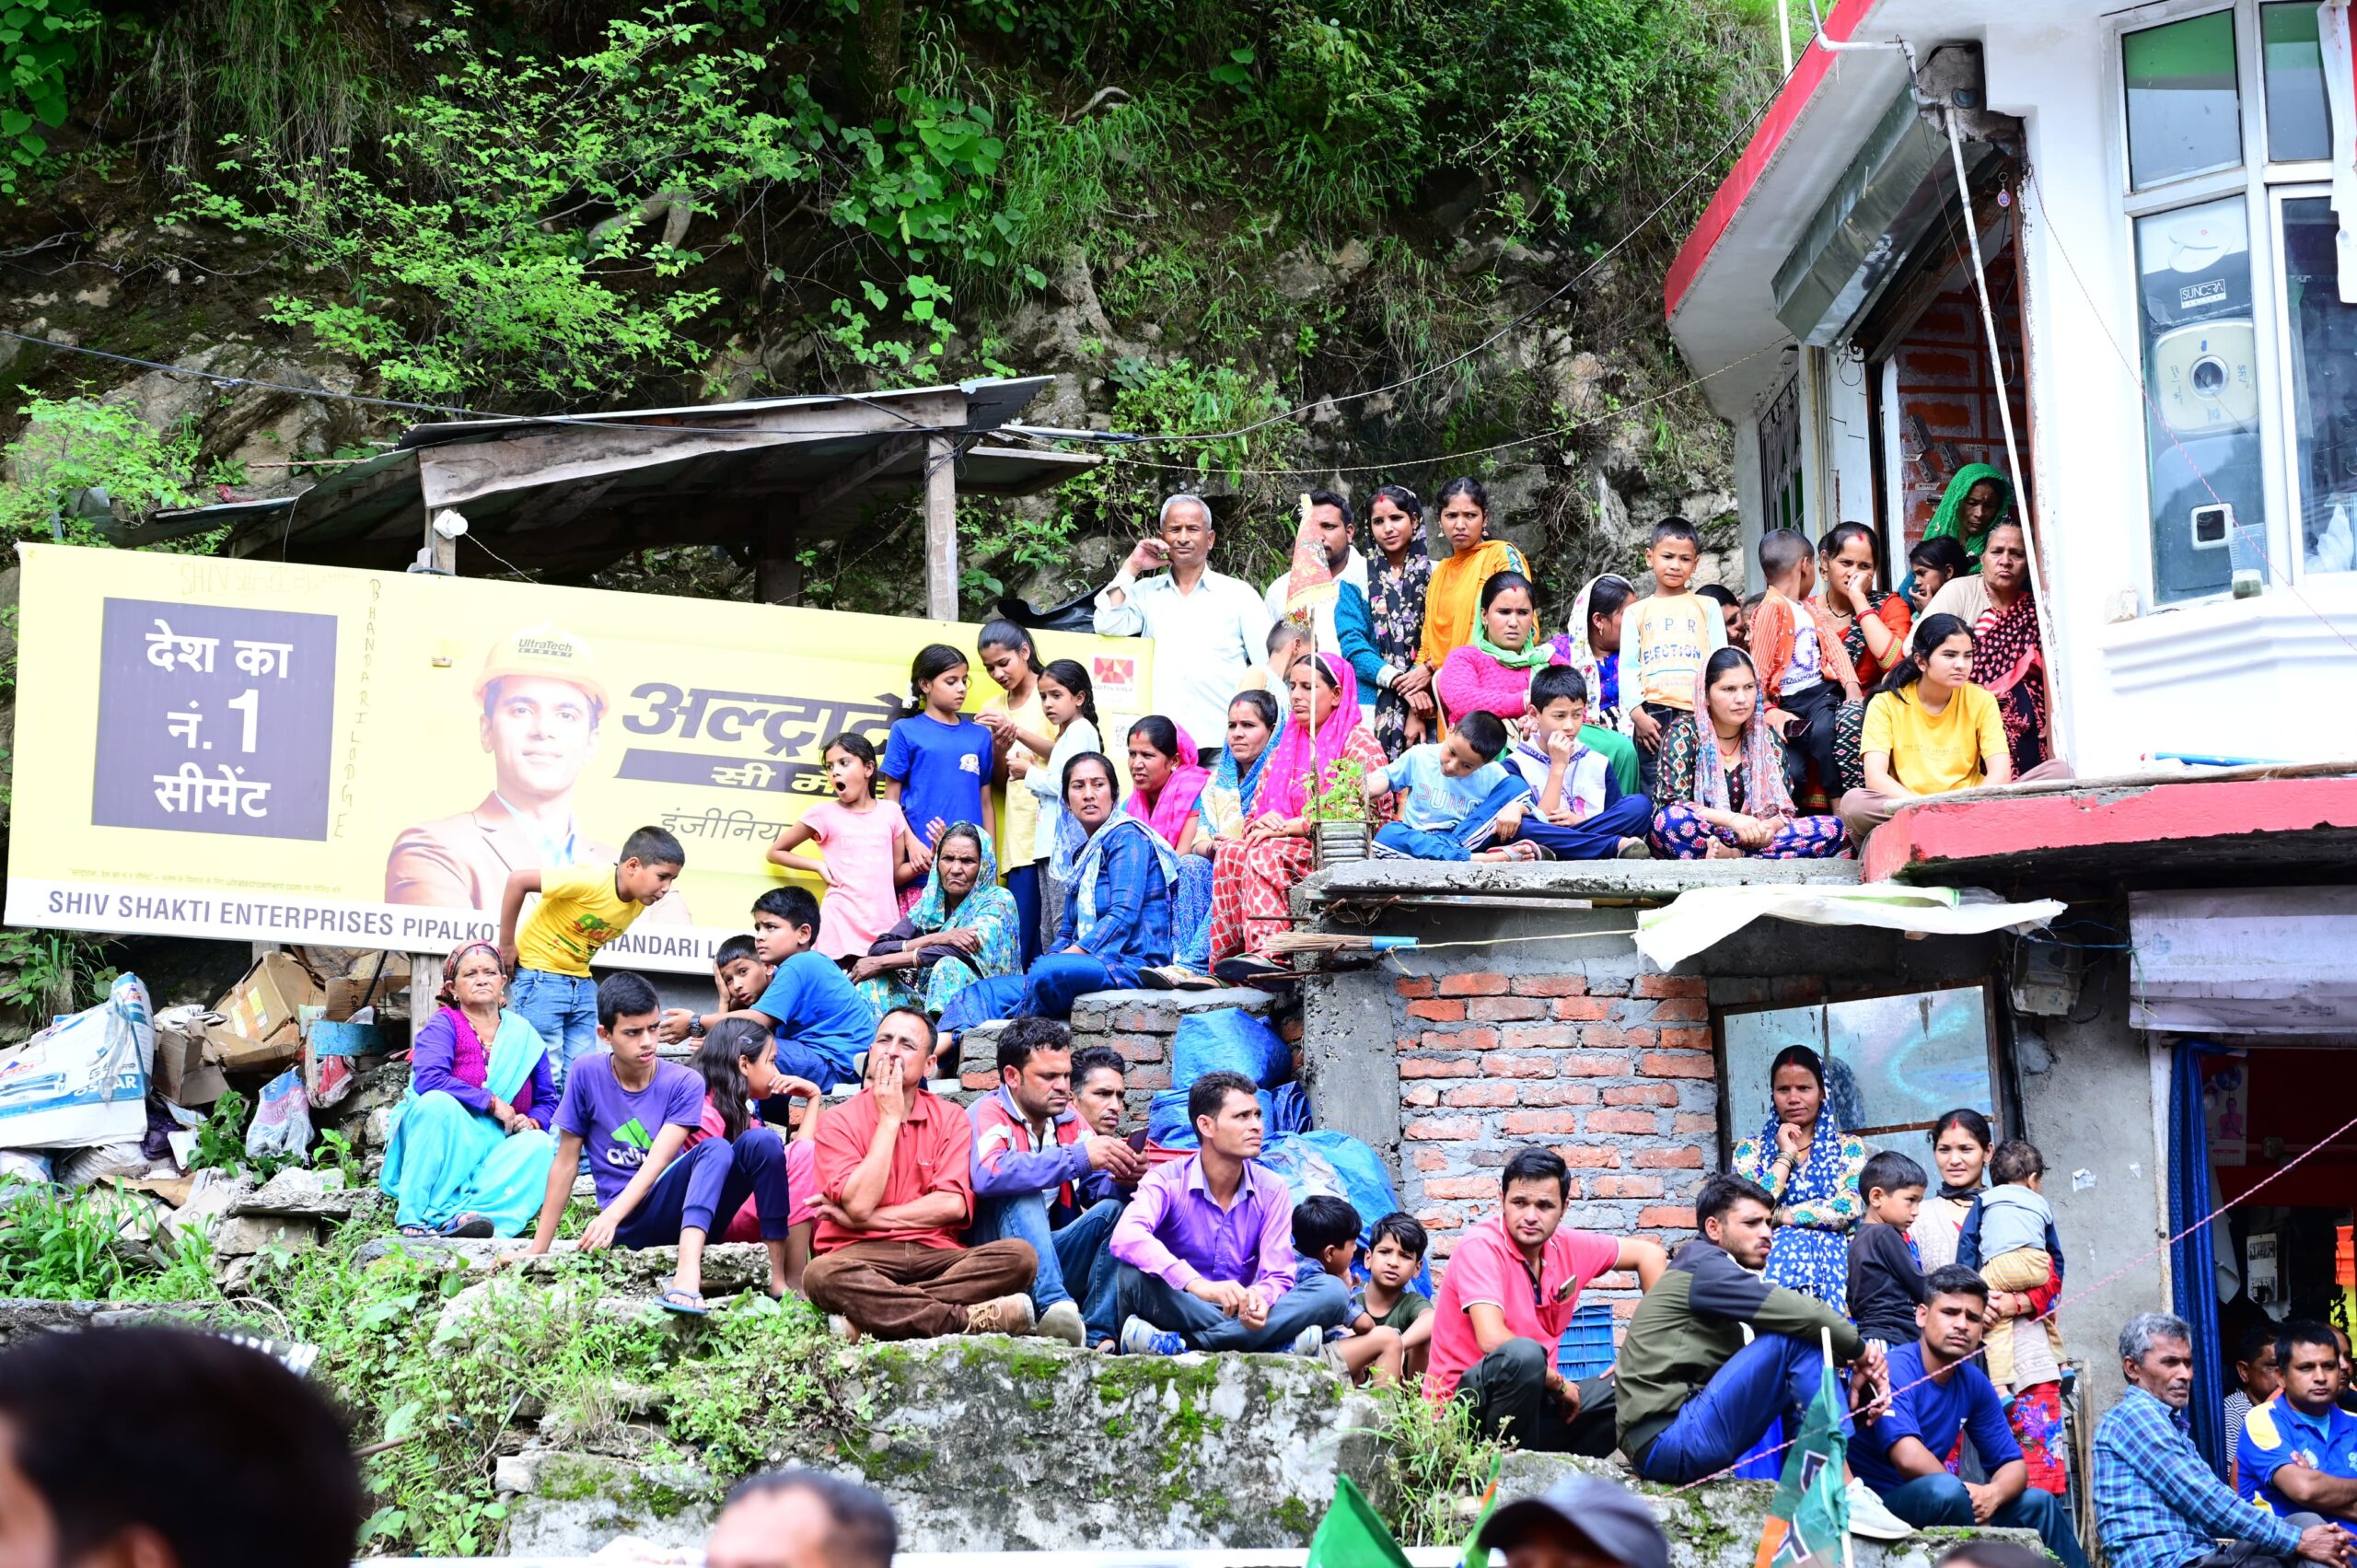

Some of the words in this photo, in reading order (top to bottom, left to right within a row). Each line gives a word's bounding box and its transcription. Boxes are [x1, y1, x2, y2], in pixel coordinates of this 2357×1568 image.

[2181, 281, 2225, 300] SUNCERA
[145, 618, 220, 673] देश
[233, 639, 295, 679] का
[518, 638, 573, 652] UltraTech
[167, 699, 213, 750] नं.
[227, 688, 259, 753] 1
[622, 682, 906, 757] अल्ट्राटे
[153, 761, 273, 818] सीमेंट
[661, 807, 793, 842] इंजीनिय
[48, 889, 110, 917] SHIV
[118, 894, 212, 923] SHAKTI
[219, 901, 394, 935] ENTERPRISES
[602, 934, 699, 958] HANDARI
